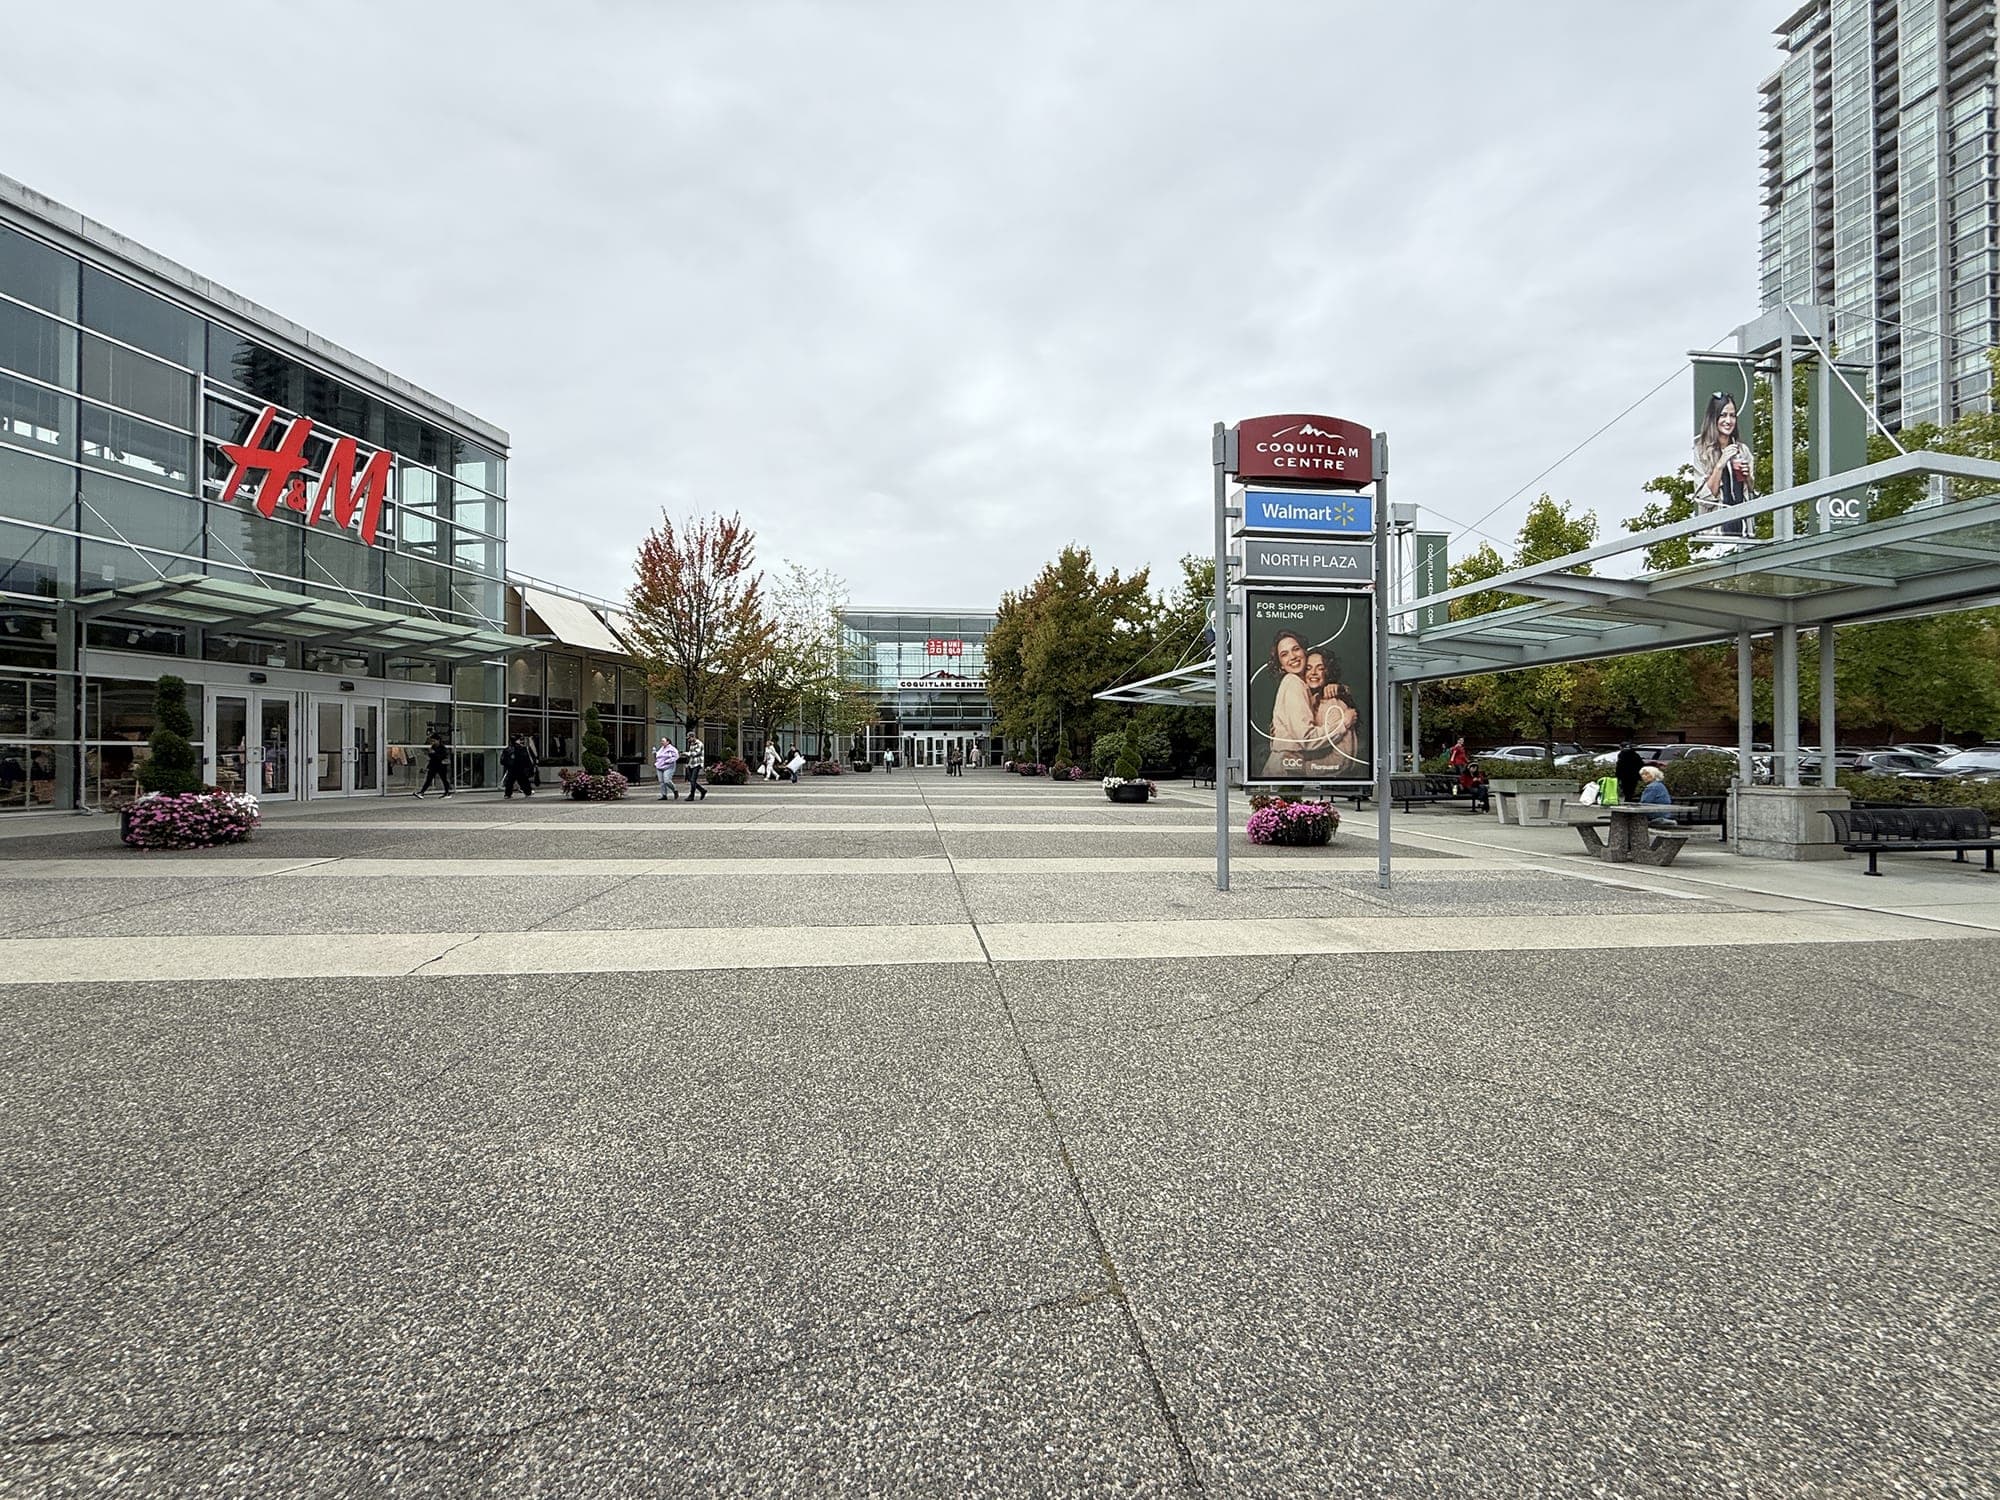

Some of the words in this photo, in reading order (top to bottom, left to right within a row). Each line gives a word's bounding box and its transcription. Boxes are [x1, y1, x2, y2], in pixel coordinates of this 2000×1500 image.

[1256, 442, 1359, 459] COQUITLAM
[1273, 457, 1345, 471] CENTRE
[217, 406, 393, 547] H&M
[1262, 502, 1332, 521] Walmart
[1260, 552, 1309, 567] NORTH
[1313, 554, 1358, 569] PLAZA
[1256, 602, 1276, 610] FOR
[1278, 602, 1326, 612] SHOPPING
[1256, 610, 1263, 618] &
[1265, 611, 1304, 619] SMILING
